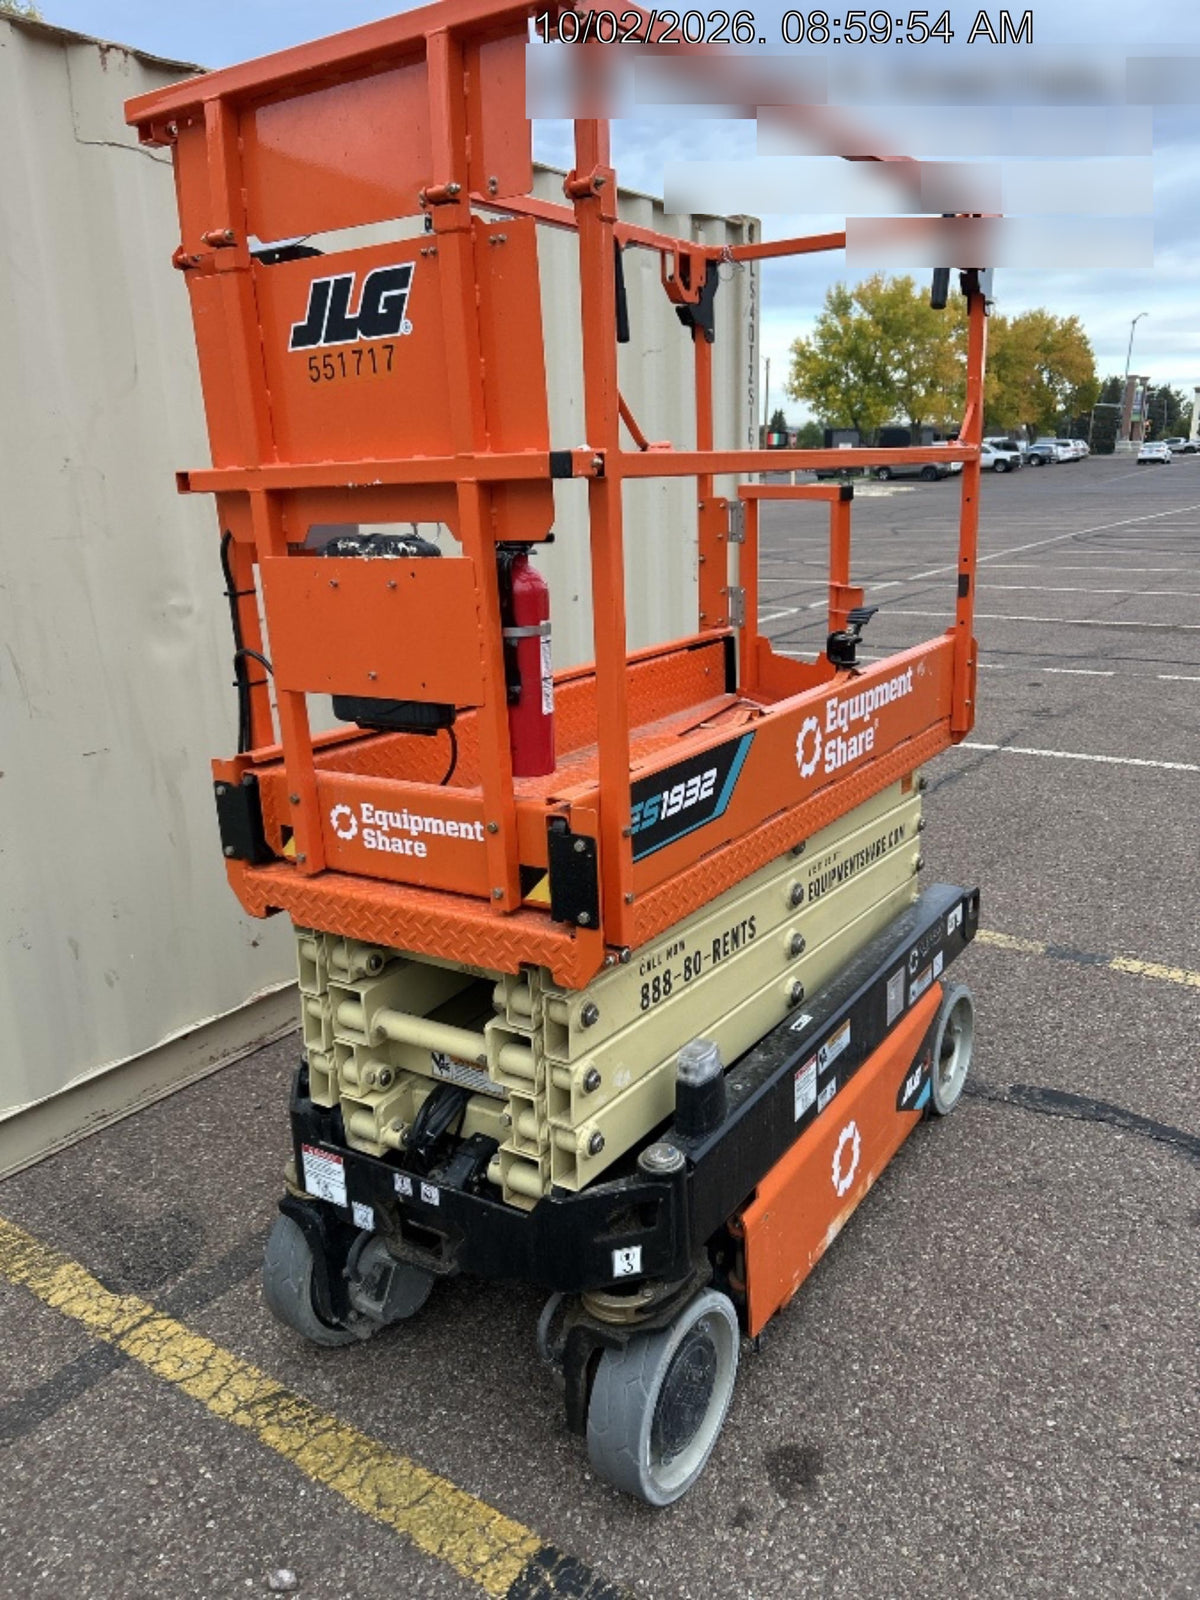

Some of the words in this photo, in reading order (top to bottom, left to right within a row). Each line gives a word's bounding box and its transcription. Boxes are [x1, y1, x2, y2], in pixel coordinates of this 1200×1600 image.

[308, 344, 394, 383] 551717
[825, 666, 914, 733] Equipment
[824, 725, 875, 774] Share
[360, 803, 485, 842] Equipment
[362, 830, 428, 858] Share
[639, 915, 757, 1011] 888-80-RENTS
[639, 954, 662, 977] CALL
